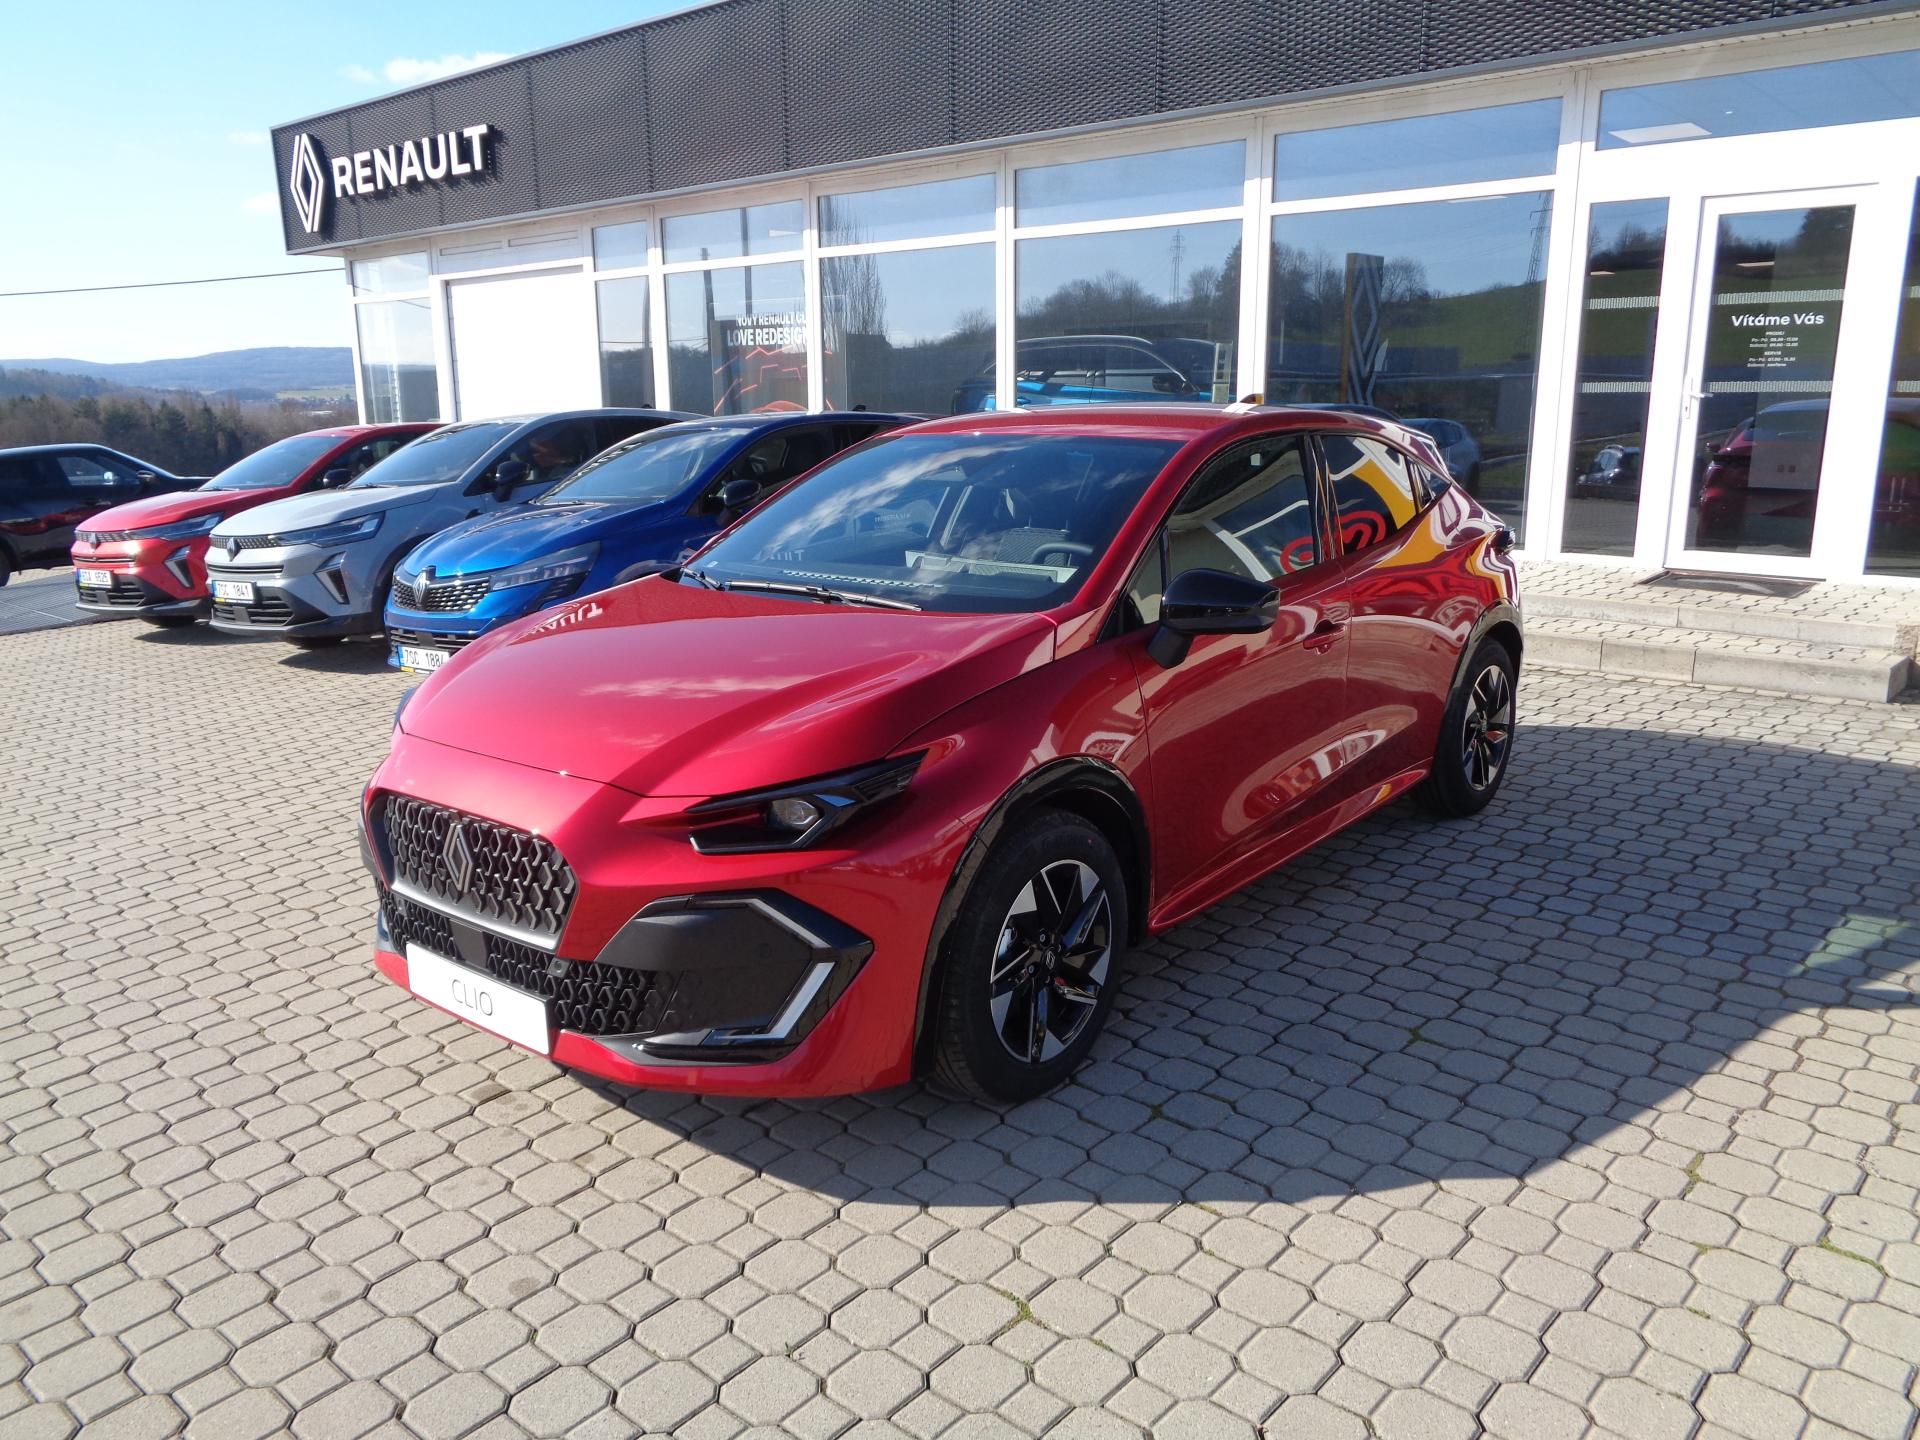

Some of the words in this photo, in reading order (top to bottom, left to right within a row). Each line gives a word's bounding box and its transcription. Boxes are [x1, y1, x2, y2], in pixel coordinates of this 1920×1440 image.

[331, 124, 488, 198] RENAULT
[759, 312, 794, 325] RENAULT
[1731, 314, 1791, 327] Vítáme
[1793, 312, 1825, 325] Vás
[727, 329, 755, 346] LOVE
[404, 649, 420, 665] 7SC
[452, 979, 493, 1016] CLIO
